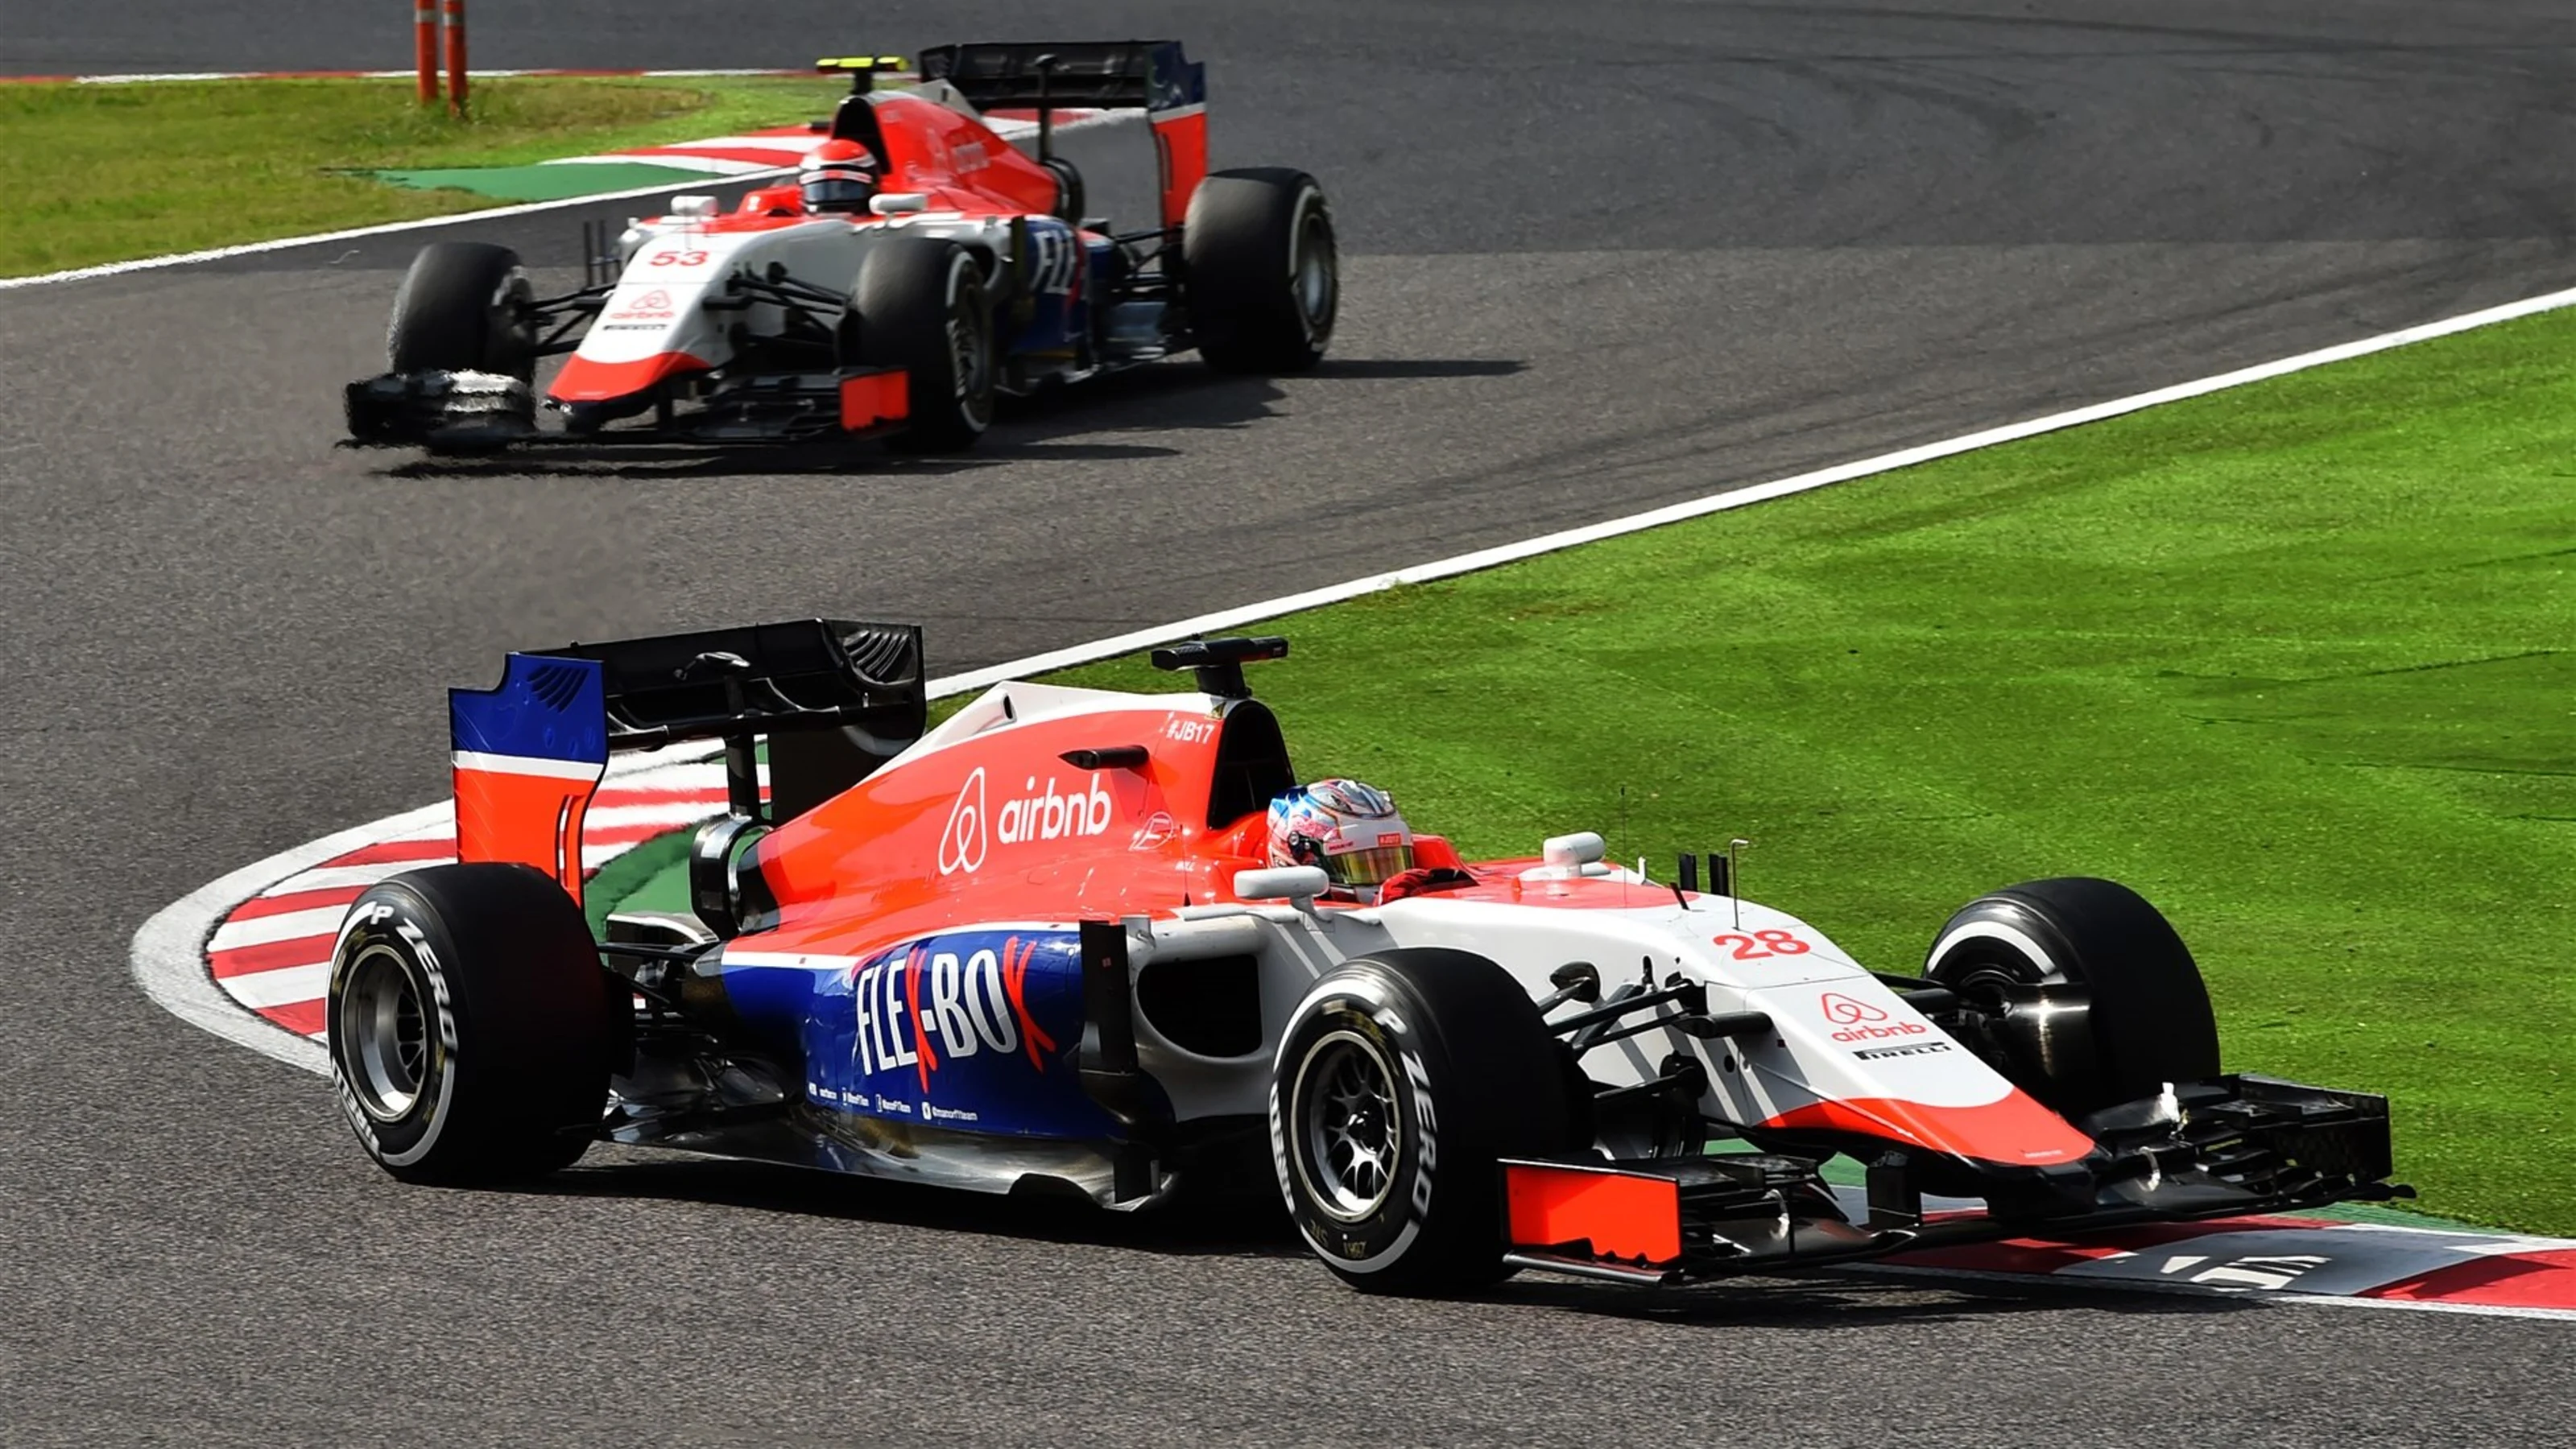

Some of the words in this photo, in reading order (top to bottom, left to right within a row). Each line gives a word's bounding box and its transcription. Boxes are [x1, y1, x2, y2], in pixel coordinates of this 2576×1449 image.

[649, 250, 709, 266] 53
[1166, 718, 1215, 745] #JB17
[998, 772, 1112, 844] airbnb
[1713, 929, 1811, 961] 28
[370, 905, 395, 925] P
[395, 917, 458, 1052] ZERO
[856, 935, 1057, 1095] FLEX-BOX
[1831, 1021, 1926, 1042] airbnb
[1852, 1042, 1952, 1060] PIRELLI
[1372, 1007, 1408, 1034] P
[1400, 1050, 1437, 1217] ZERO
